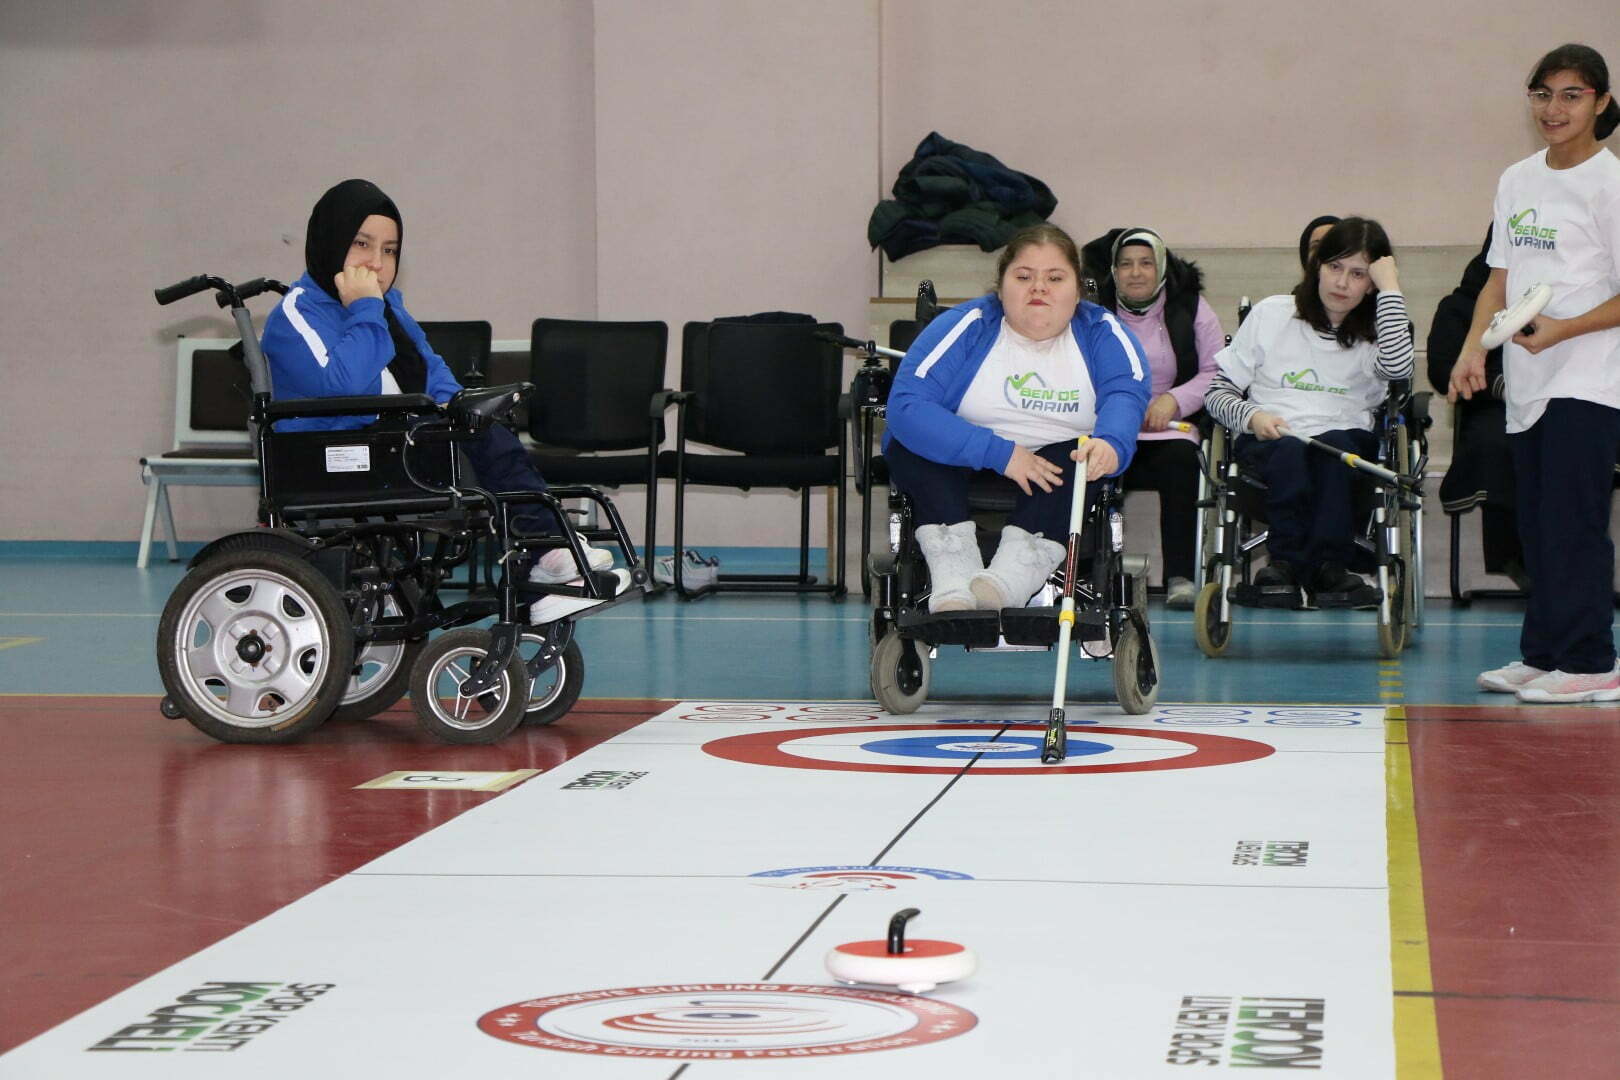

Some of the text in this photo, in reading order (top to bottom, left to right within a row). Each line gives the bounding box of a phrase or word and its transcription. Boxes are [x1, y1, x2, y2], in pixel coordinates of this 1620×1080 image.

[1514, 236, 1555, 250] VARIM
[1020, 387, 1080, 402] BEN DE
[1021, 398, 1080, 413] VARIM
[637, 984, 780, 994] CURLING
[248, 982, 337, 1012] SPOR
[602, 1046, 734, 1060] Curling
[1166, 1033, 1225, 1066] SPOR
